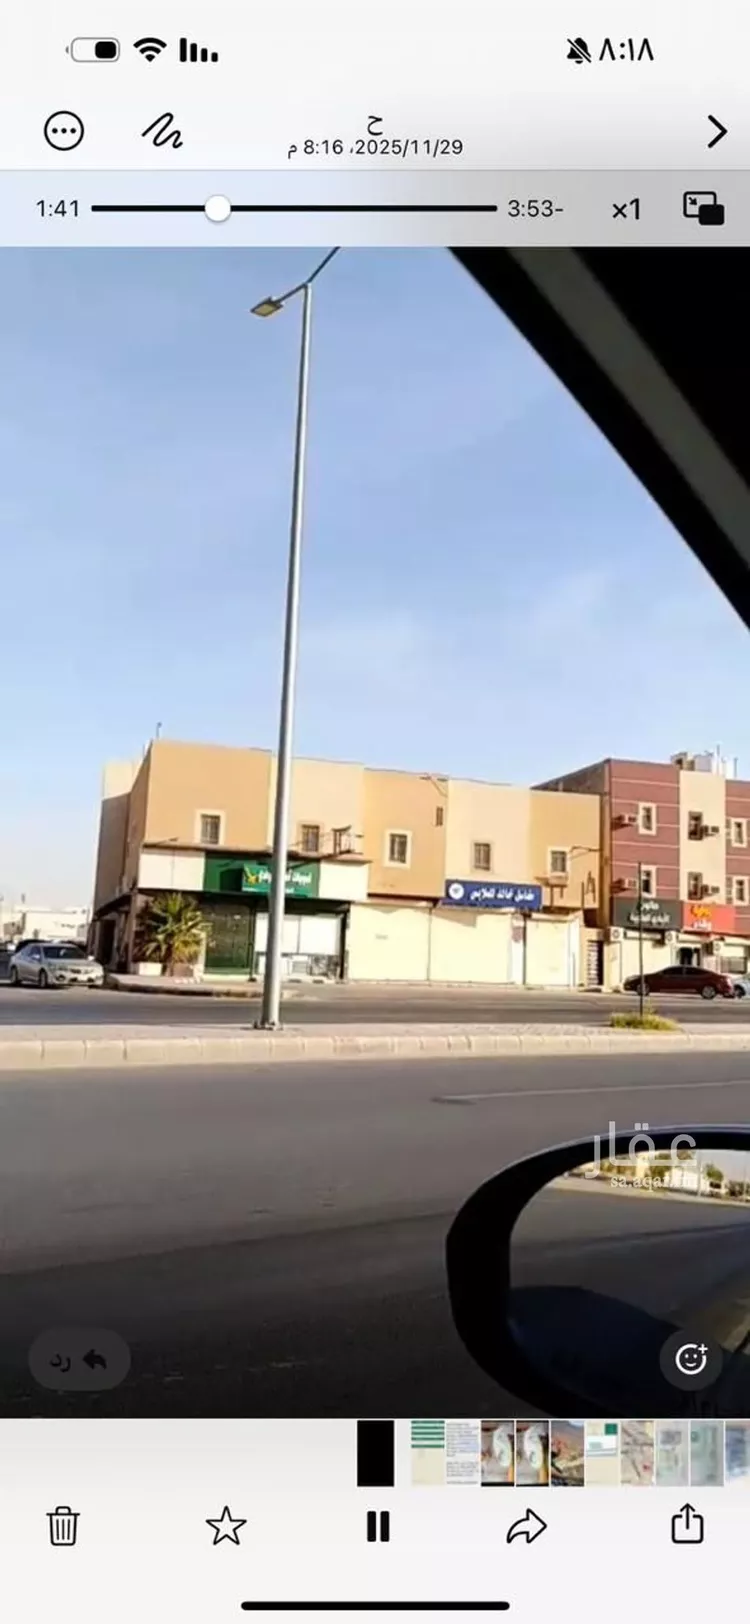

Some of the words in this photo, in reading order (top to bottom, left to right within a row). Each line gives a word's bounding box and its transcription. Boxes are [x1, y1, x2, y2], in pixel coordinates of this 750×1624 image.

[598, 38, 655, 62] ٨:١٨
[366, 115, 384, 137] ح
[287, 144, 298, 160] م
[303, 138, 344, 155] 8:16
[36, 199, 79, 218] 1:41
[49, 1353, 72, 1374] رد
